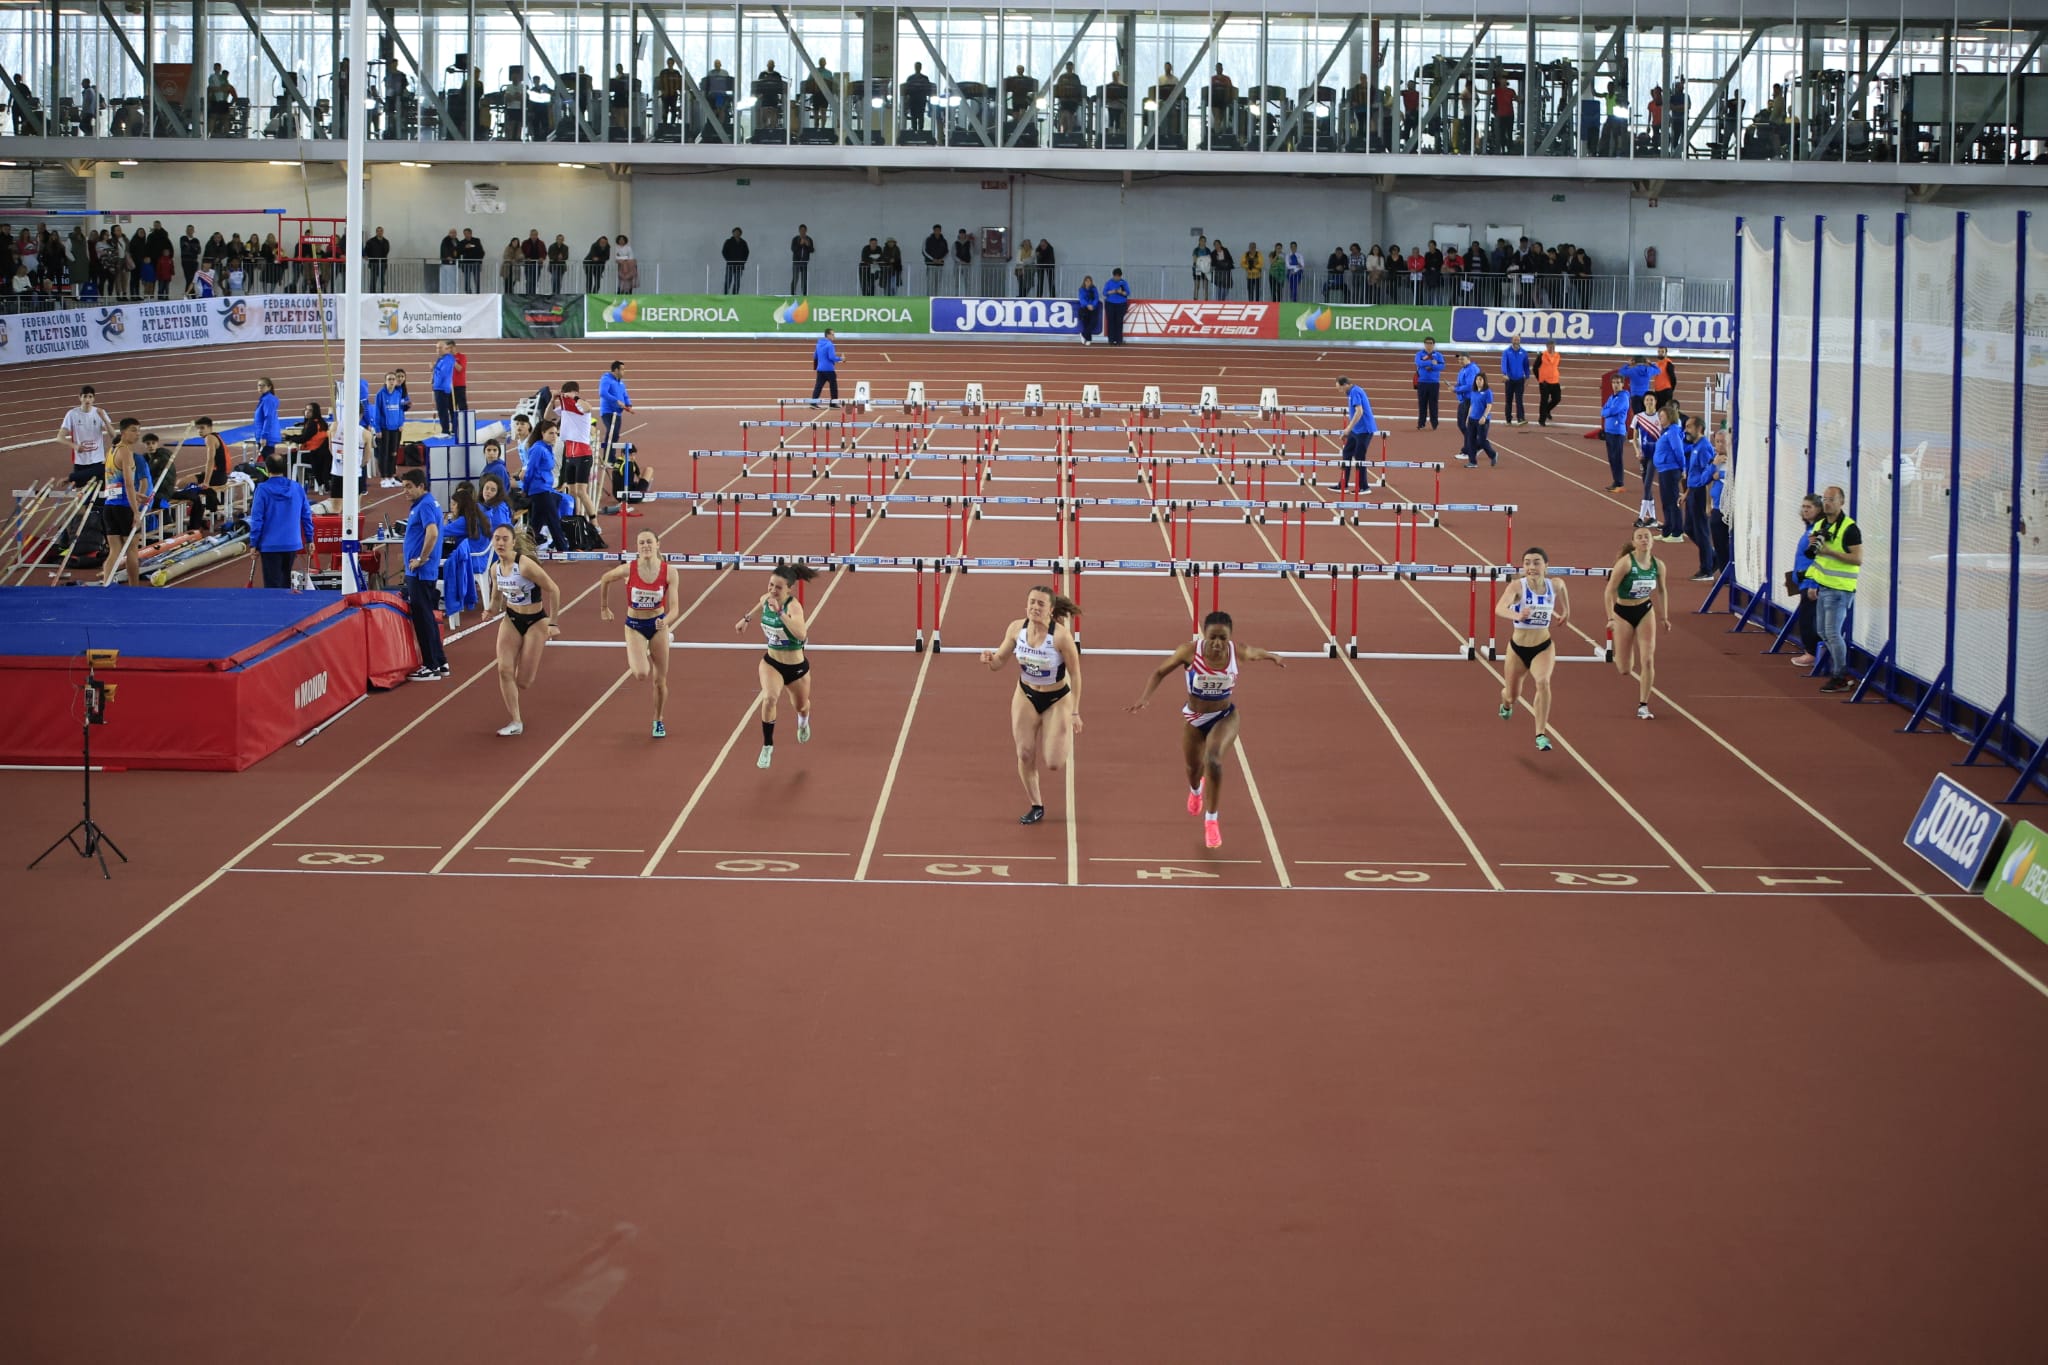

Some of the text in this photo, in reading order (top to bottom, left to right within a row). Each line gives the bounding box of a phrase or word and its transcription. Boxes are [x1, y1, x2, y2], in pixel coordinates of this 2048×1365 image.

[139, 302, 207, 317] FEDERACIÓN DE
[263, 297, 333, 308] FEDERACIÓN DE
[75, 312, 86, 323] DE
[402, 311, 462, 326] Ayuntamiento
[641, 308, 739, 322] IBERDROLA
[813, 308, 912, 322] IBERDROLA
[1171, 304, 1269, 325] RFEA
[141, 314, 209, 332] ATLETISMO
[264, 325, 274, 335] DE
[275, 324, 307, 334] CASTILLA
[403, 323, 462, 335] de Salamanca
[1167, 325, 1259, 335] ATLETISMO
[1335, 315, 1434, 332] IBERDROLA
[1643, 314, 1735, 347] Jom
[24, 325, 88, 344] ATLETISMO
[142, 332, 151, 343] DE
[151, 330, 184, 343] CASTILLA
[184, 330, 190, 341] Y
[25, 344, 36, 355] DE
[36, 341, 66, 355] CASTILLA
[976, 388, 981, 402] 6
[1035, 389, 1041, 402] 5
[1203, 392, 1210, 406] 2
[1531, 611, 1548, 620] 428
[301, 670, 328, 708] MONDO
[1202, 681, 1223, 689] 337
[1913, 784, 1990, 869] Joma
[297, 851, 385, 866] 8
[507, 855, 595, 870] 7
[714, 858, 801, 873] 6
[923, 862, 1011, 878] 5
[1135, 866, 1221, 881] 4
[1343, 868, 1431, 884] 3
[1549, 871, 1639, 887] 2
[1756, 874, 1844, 887] 1
